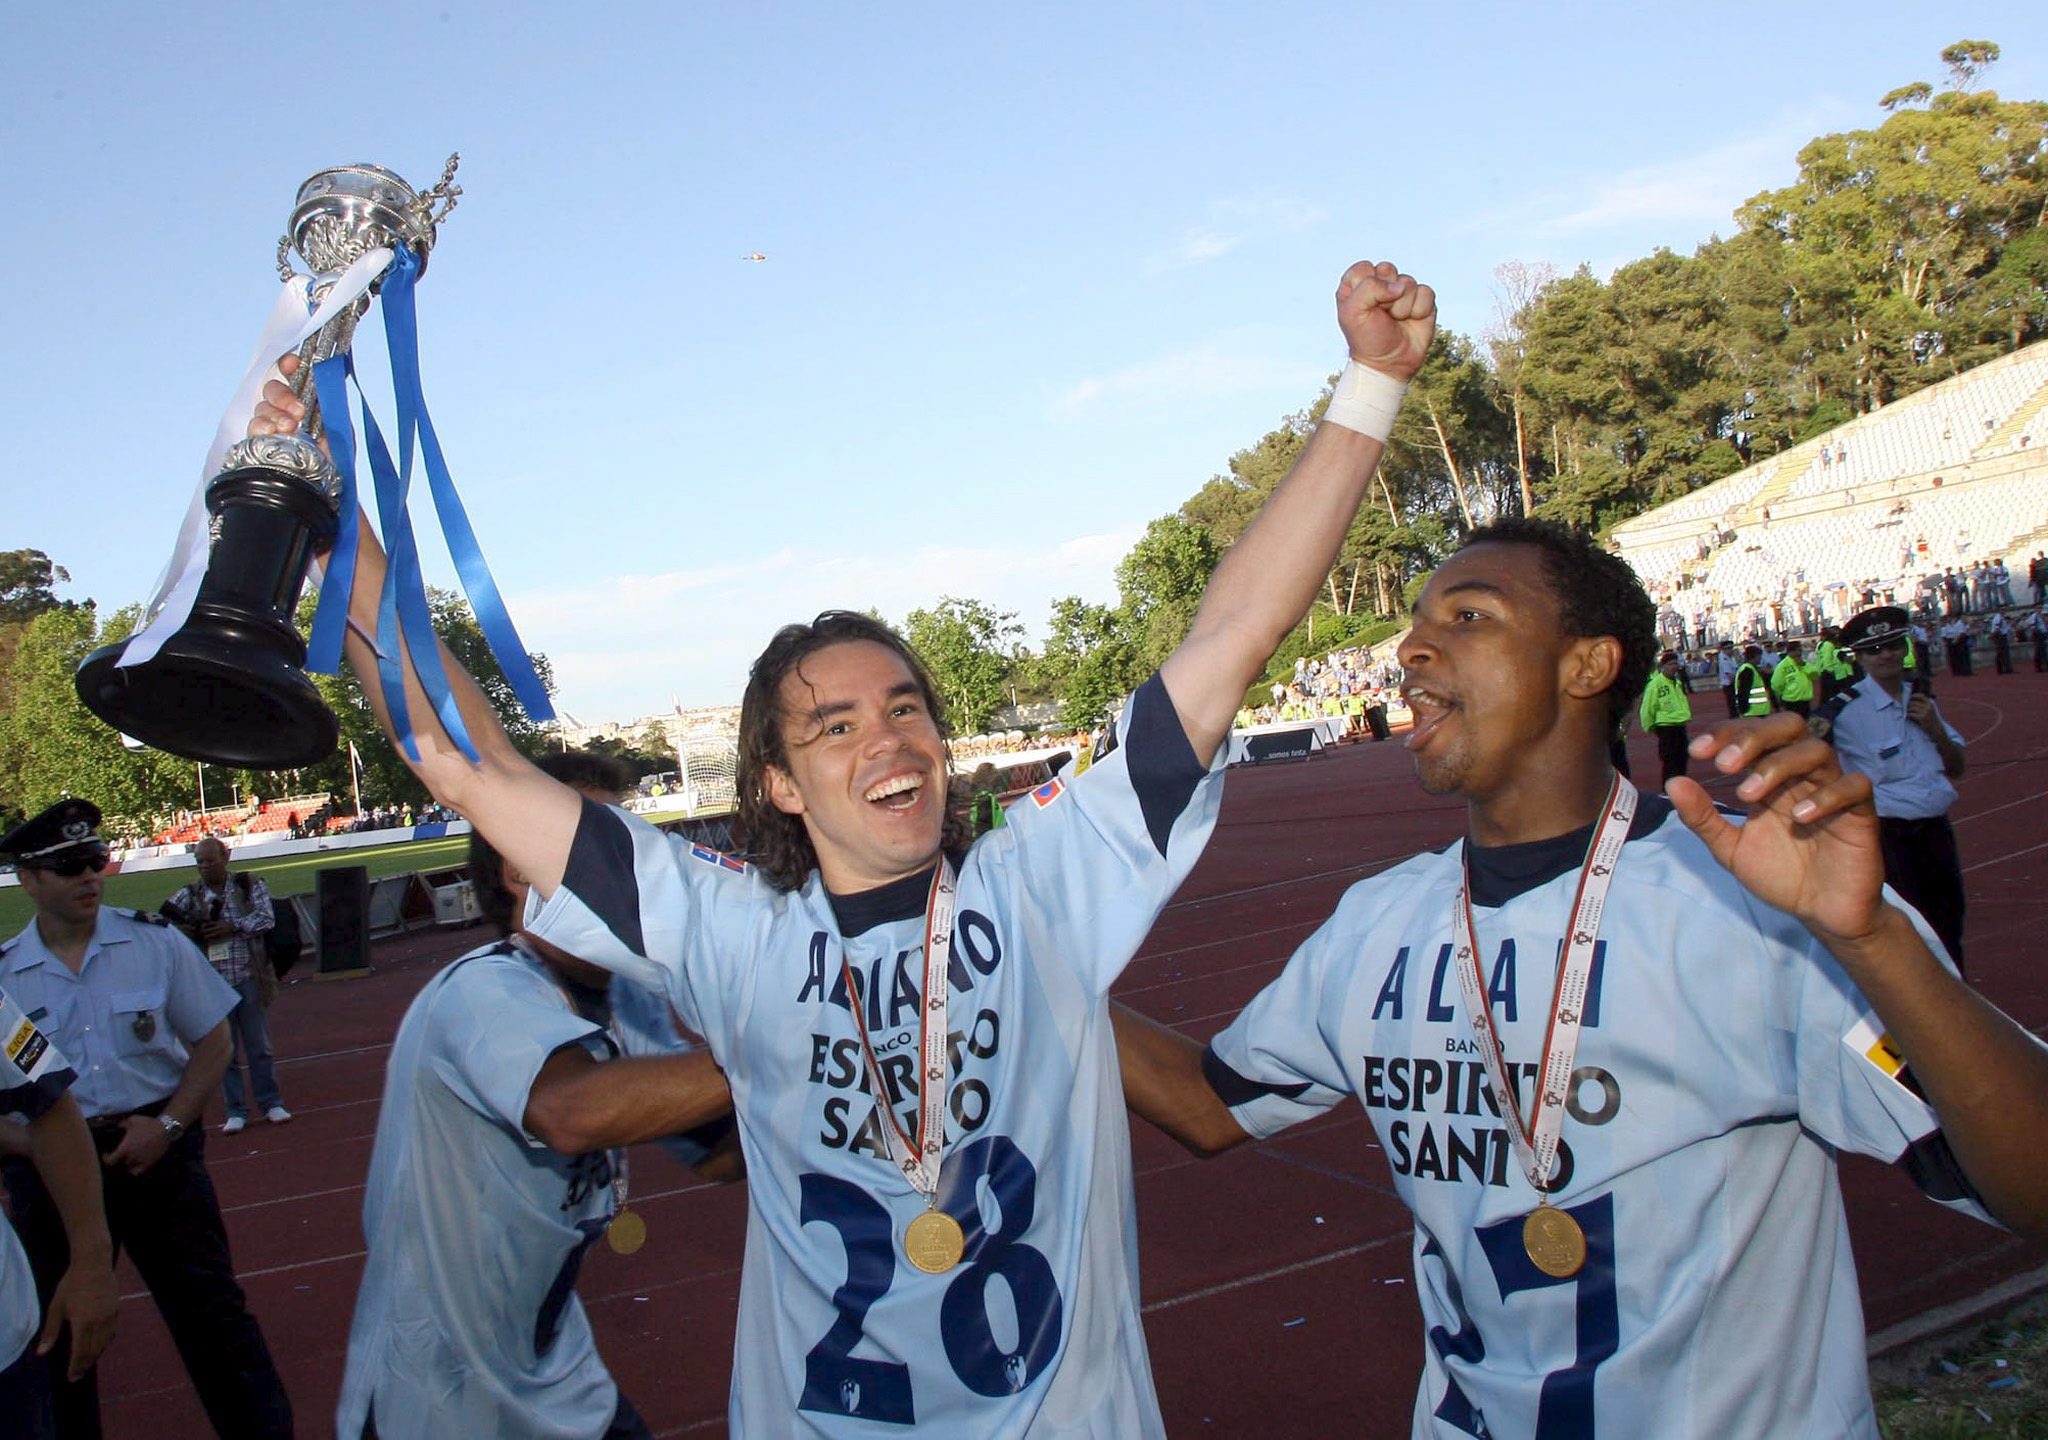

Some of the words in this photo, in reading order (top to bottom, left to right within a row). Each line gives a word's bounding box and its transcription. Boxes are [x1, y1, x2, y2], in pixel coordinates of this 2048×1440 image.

[7, 1026, 32, 1055] LIGA
[808, 1008, 999, 1104] ESRTO
[1445, 1038, 1505, 1053] BANO
[821, 1078, 990, 1160] SAO
[1390, 1121, 1574, 1194] SANTO
[798, 1135, 1063, 1425] 28
